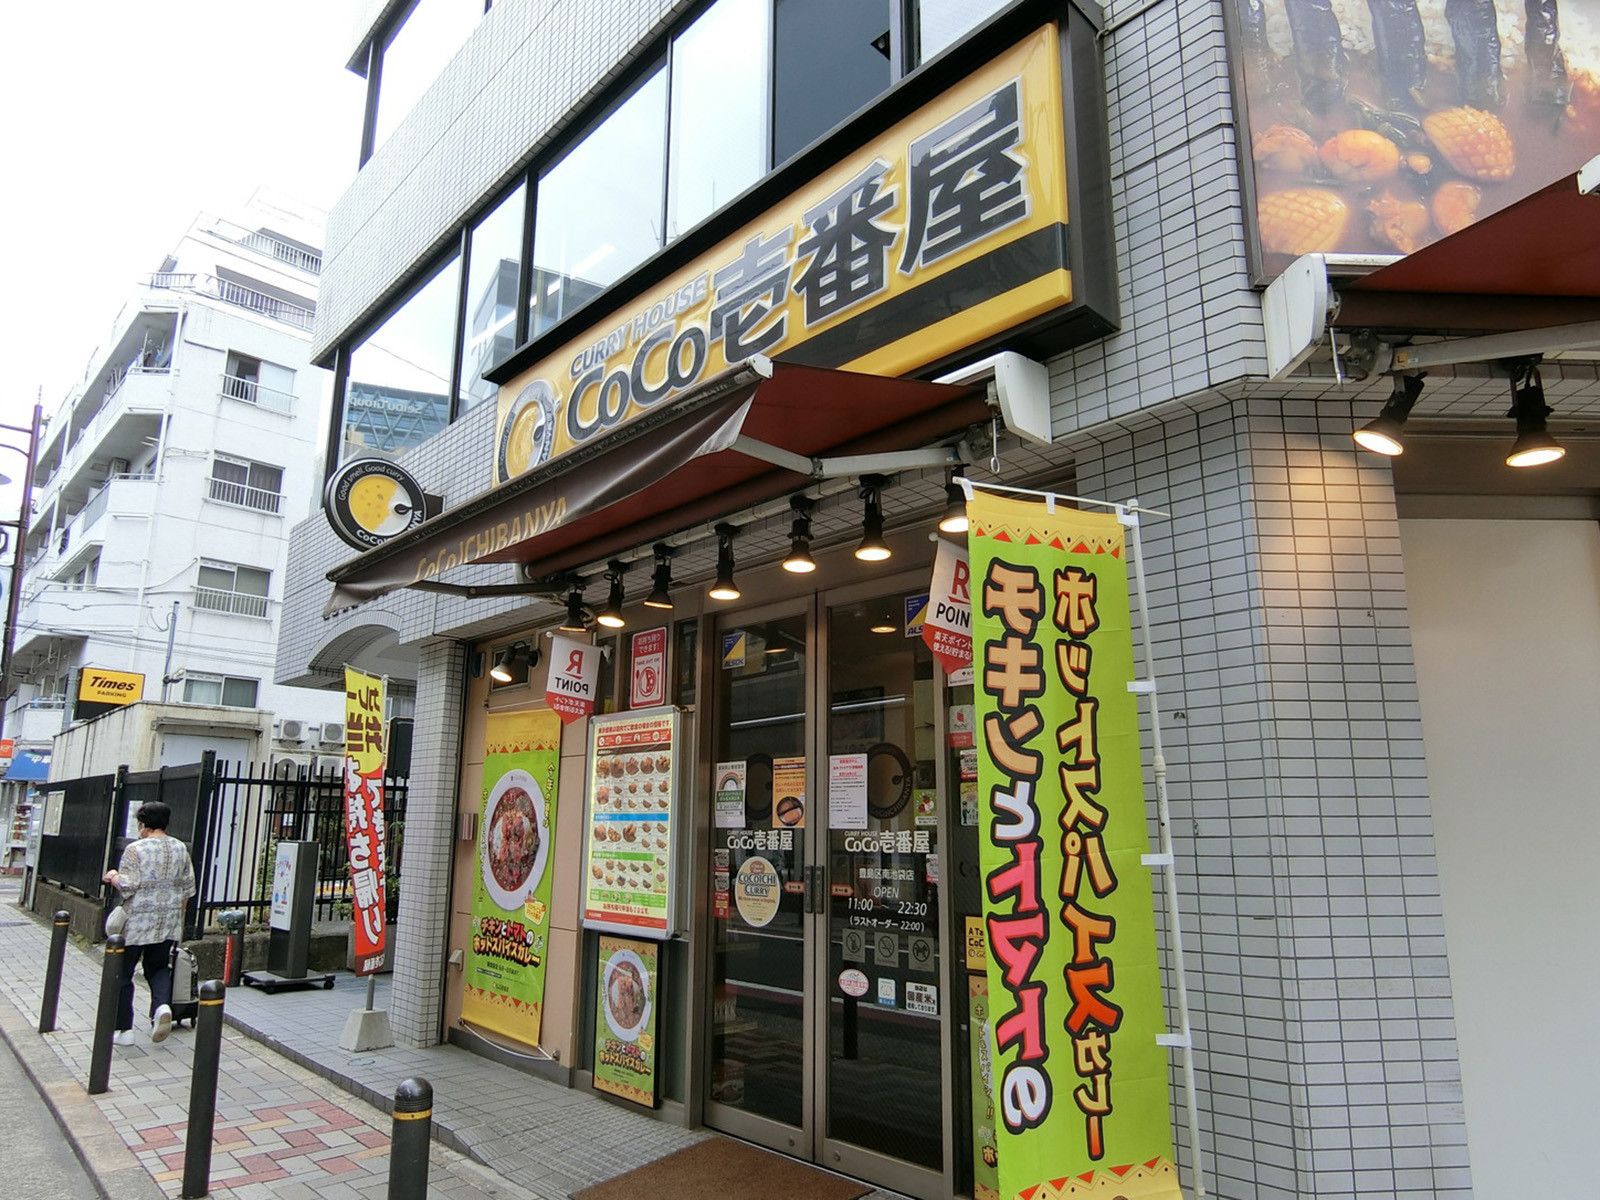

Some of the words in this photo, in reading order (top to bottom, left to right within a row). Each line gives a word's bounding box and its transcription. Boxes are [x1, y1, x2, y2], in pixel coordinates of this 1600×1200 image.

[566, 75, 1031, 443] CoCo壱番屋
[569, 325, 632, 378] CURRY
[631, 269, 710, 344] HOUSE
[338, 479, 349, 501] Good
[364, 464, 386, 473] Good
[386, 467, 406, 482] curry
[936, 603, 971, 629] POIN
[90, 676, 136, 692] Times
[97, 690, 127, 698] PARKING
[726, 830, 793, 851] CoCo壱番屋
[844, 830, 930, 854] CoCo壱番屋
[858, 867, 915, 881] 豊島区南池袋店
[873, 886, 899, 899] OPEN
[847, 897, 874, 911] 11:00
[897, 901, 928, 916] 22:30
[481, 917, 535, 947] チキンとトマトの
[900, 917, 925, 933] 22:00)
[968, 927, 974, 936] A
[974, 927, 984, 936] Ta
[473, 934, 541, 968] ホットスパイスカレー
[968, 937, 985, 947] CoC
